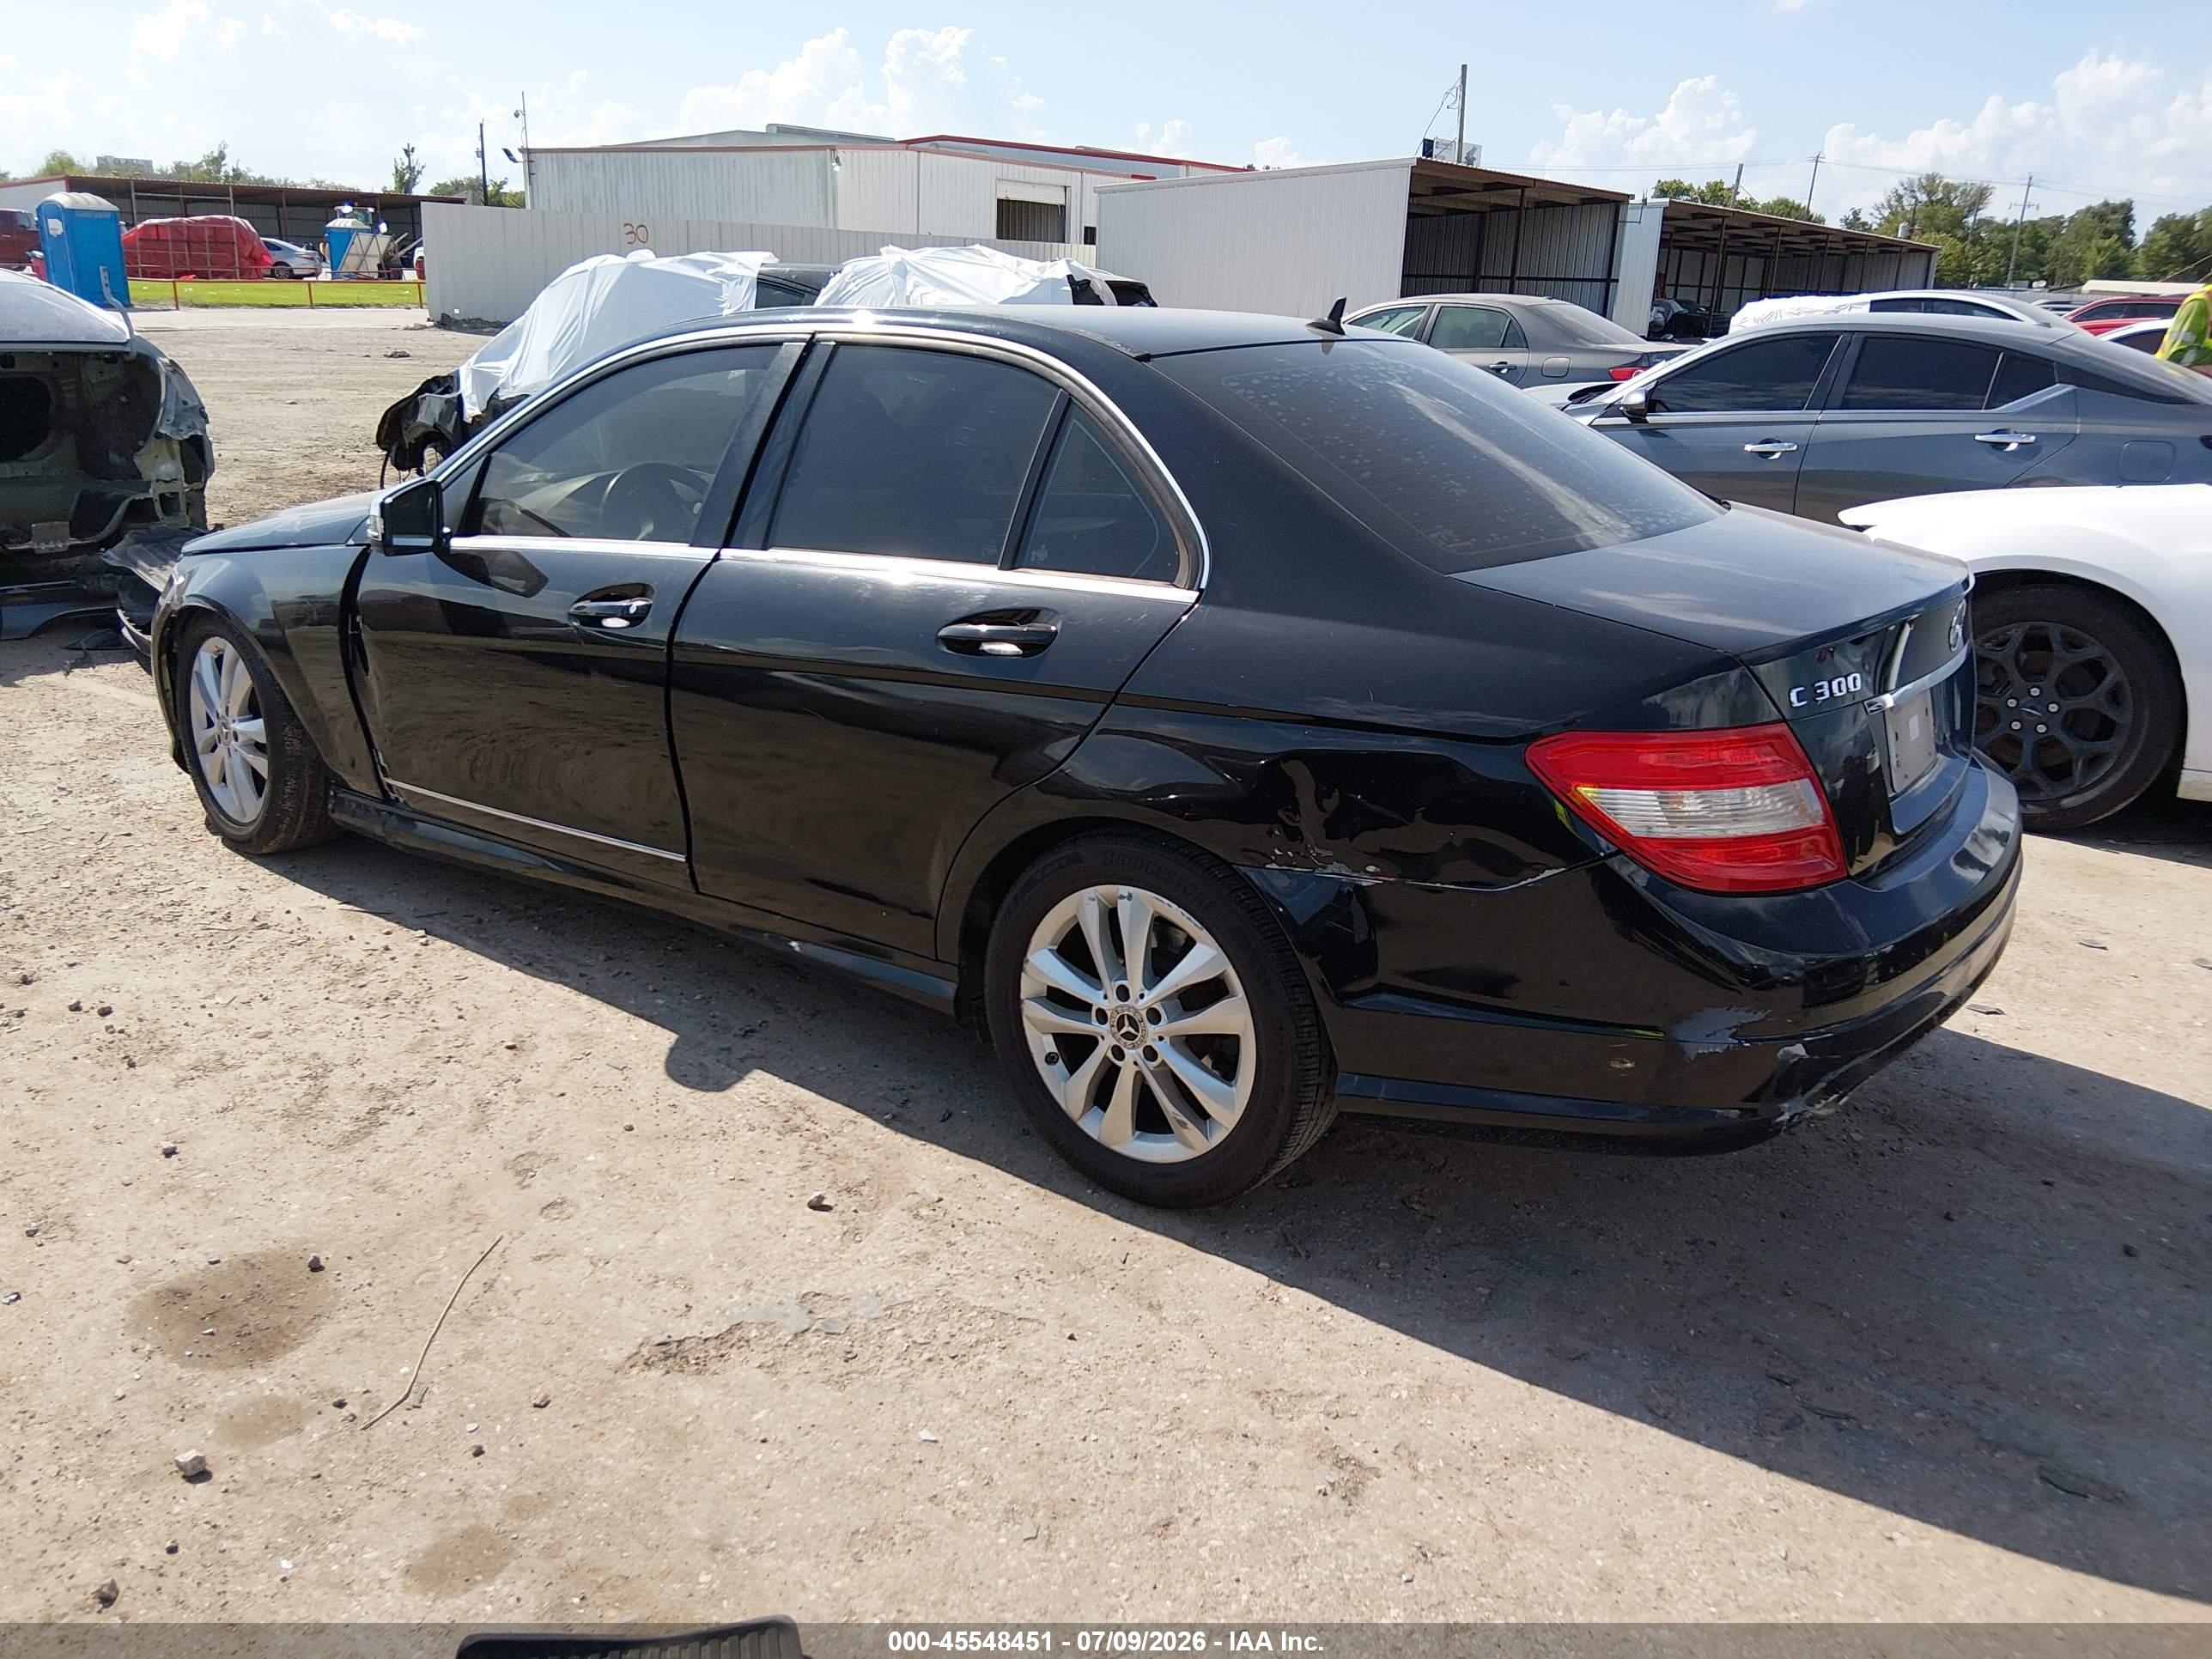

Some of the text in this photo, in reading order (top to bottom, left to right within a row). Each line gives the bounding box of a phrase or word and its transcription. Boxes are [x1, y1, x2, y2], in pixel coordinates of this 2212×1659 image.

[623, 222, 649, 245] 30
[1790, 672, 1862, 708] C 300
[1101, 849, 1214, 911] BRIDGESTONE
